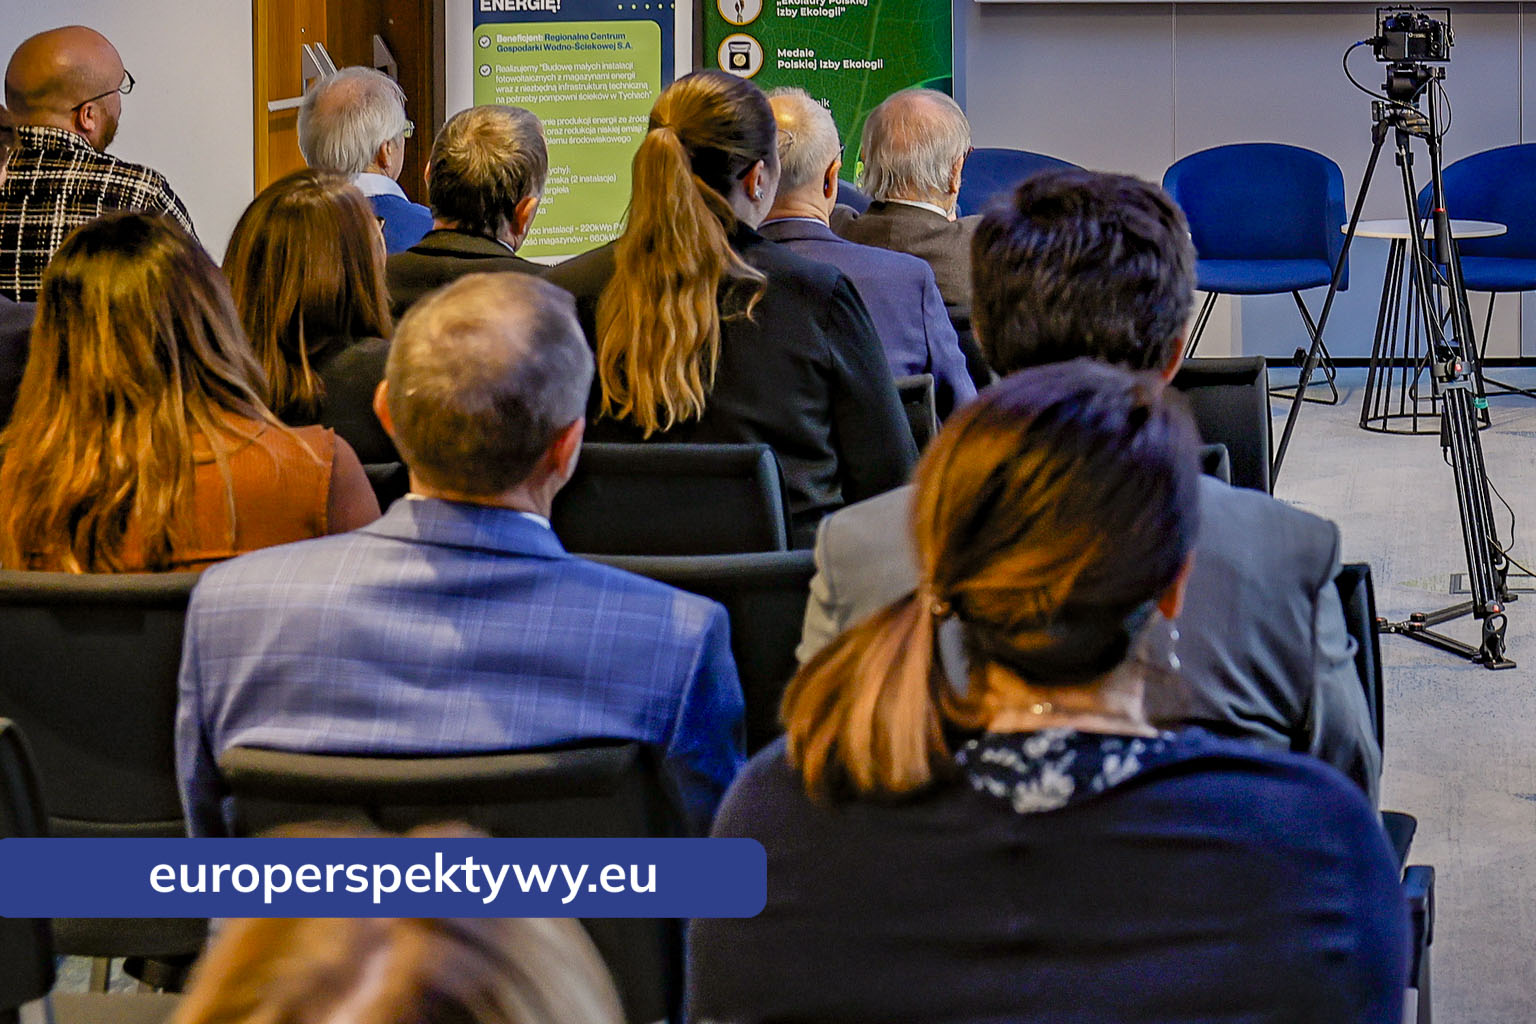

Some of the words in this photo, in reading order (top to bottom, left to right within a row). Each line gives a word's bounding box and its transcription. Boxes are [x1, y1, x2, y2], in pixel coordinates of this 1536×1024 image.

[777, 7, 799, 18] Izby
[545, 33, 589, 42] Regionalne
[497, 44, 542, 54] Gospodarki
[778, 48, 814, 58] Medale
[778, 59, 817, 70] Polskiej
[820, 59, 840, 70] Izby
[843, 59, 883, 69] Ekologii
